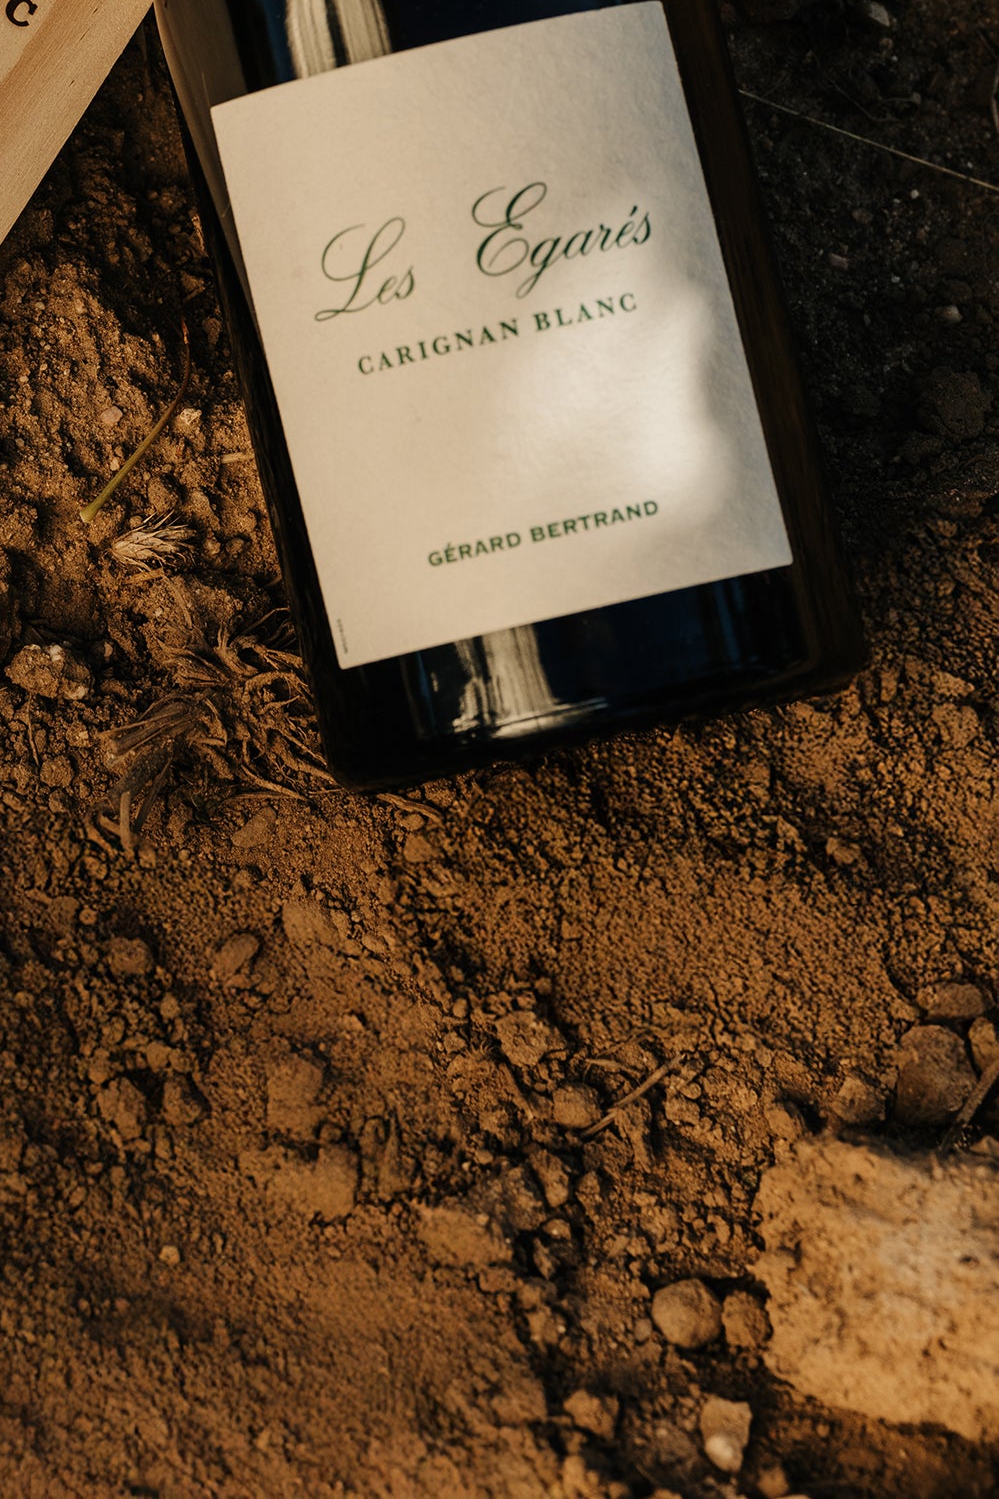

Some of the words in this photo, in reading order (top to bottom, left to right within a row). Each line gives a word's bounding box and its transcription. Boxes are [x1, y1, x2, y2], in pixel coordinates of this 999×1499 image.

[314, 216, 416, 323] Les
[470, 181, 653, 300] Egarés
[357, 318, 520, 376] CARIGNAN
[532, 293, 638, 333] BLANC
[427, 531, 522, 568] GÉRARD
[529, 500, 659, 544] BERTRAND
